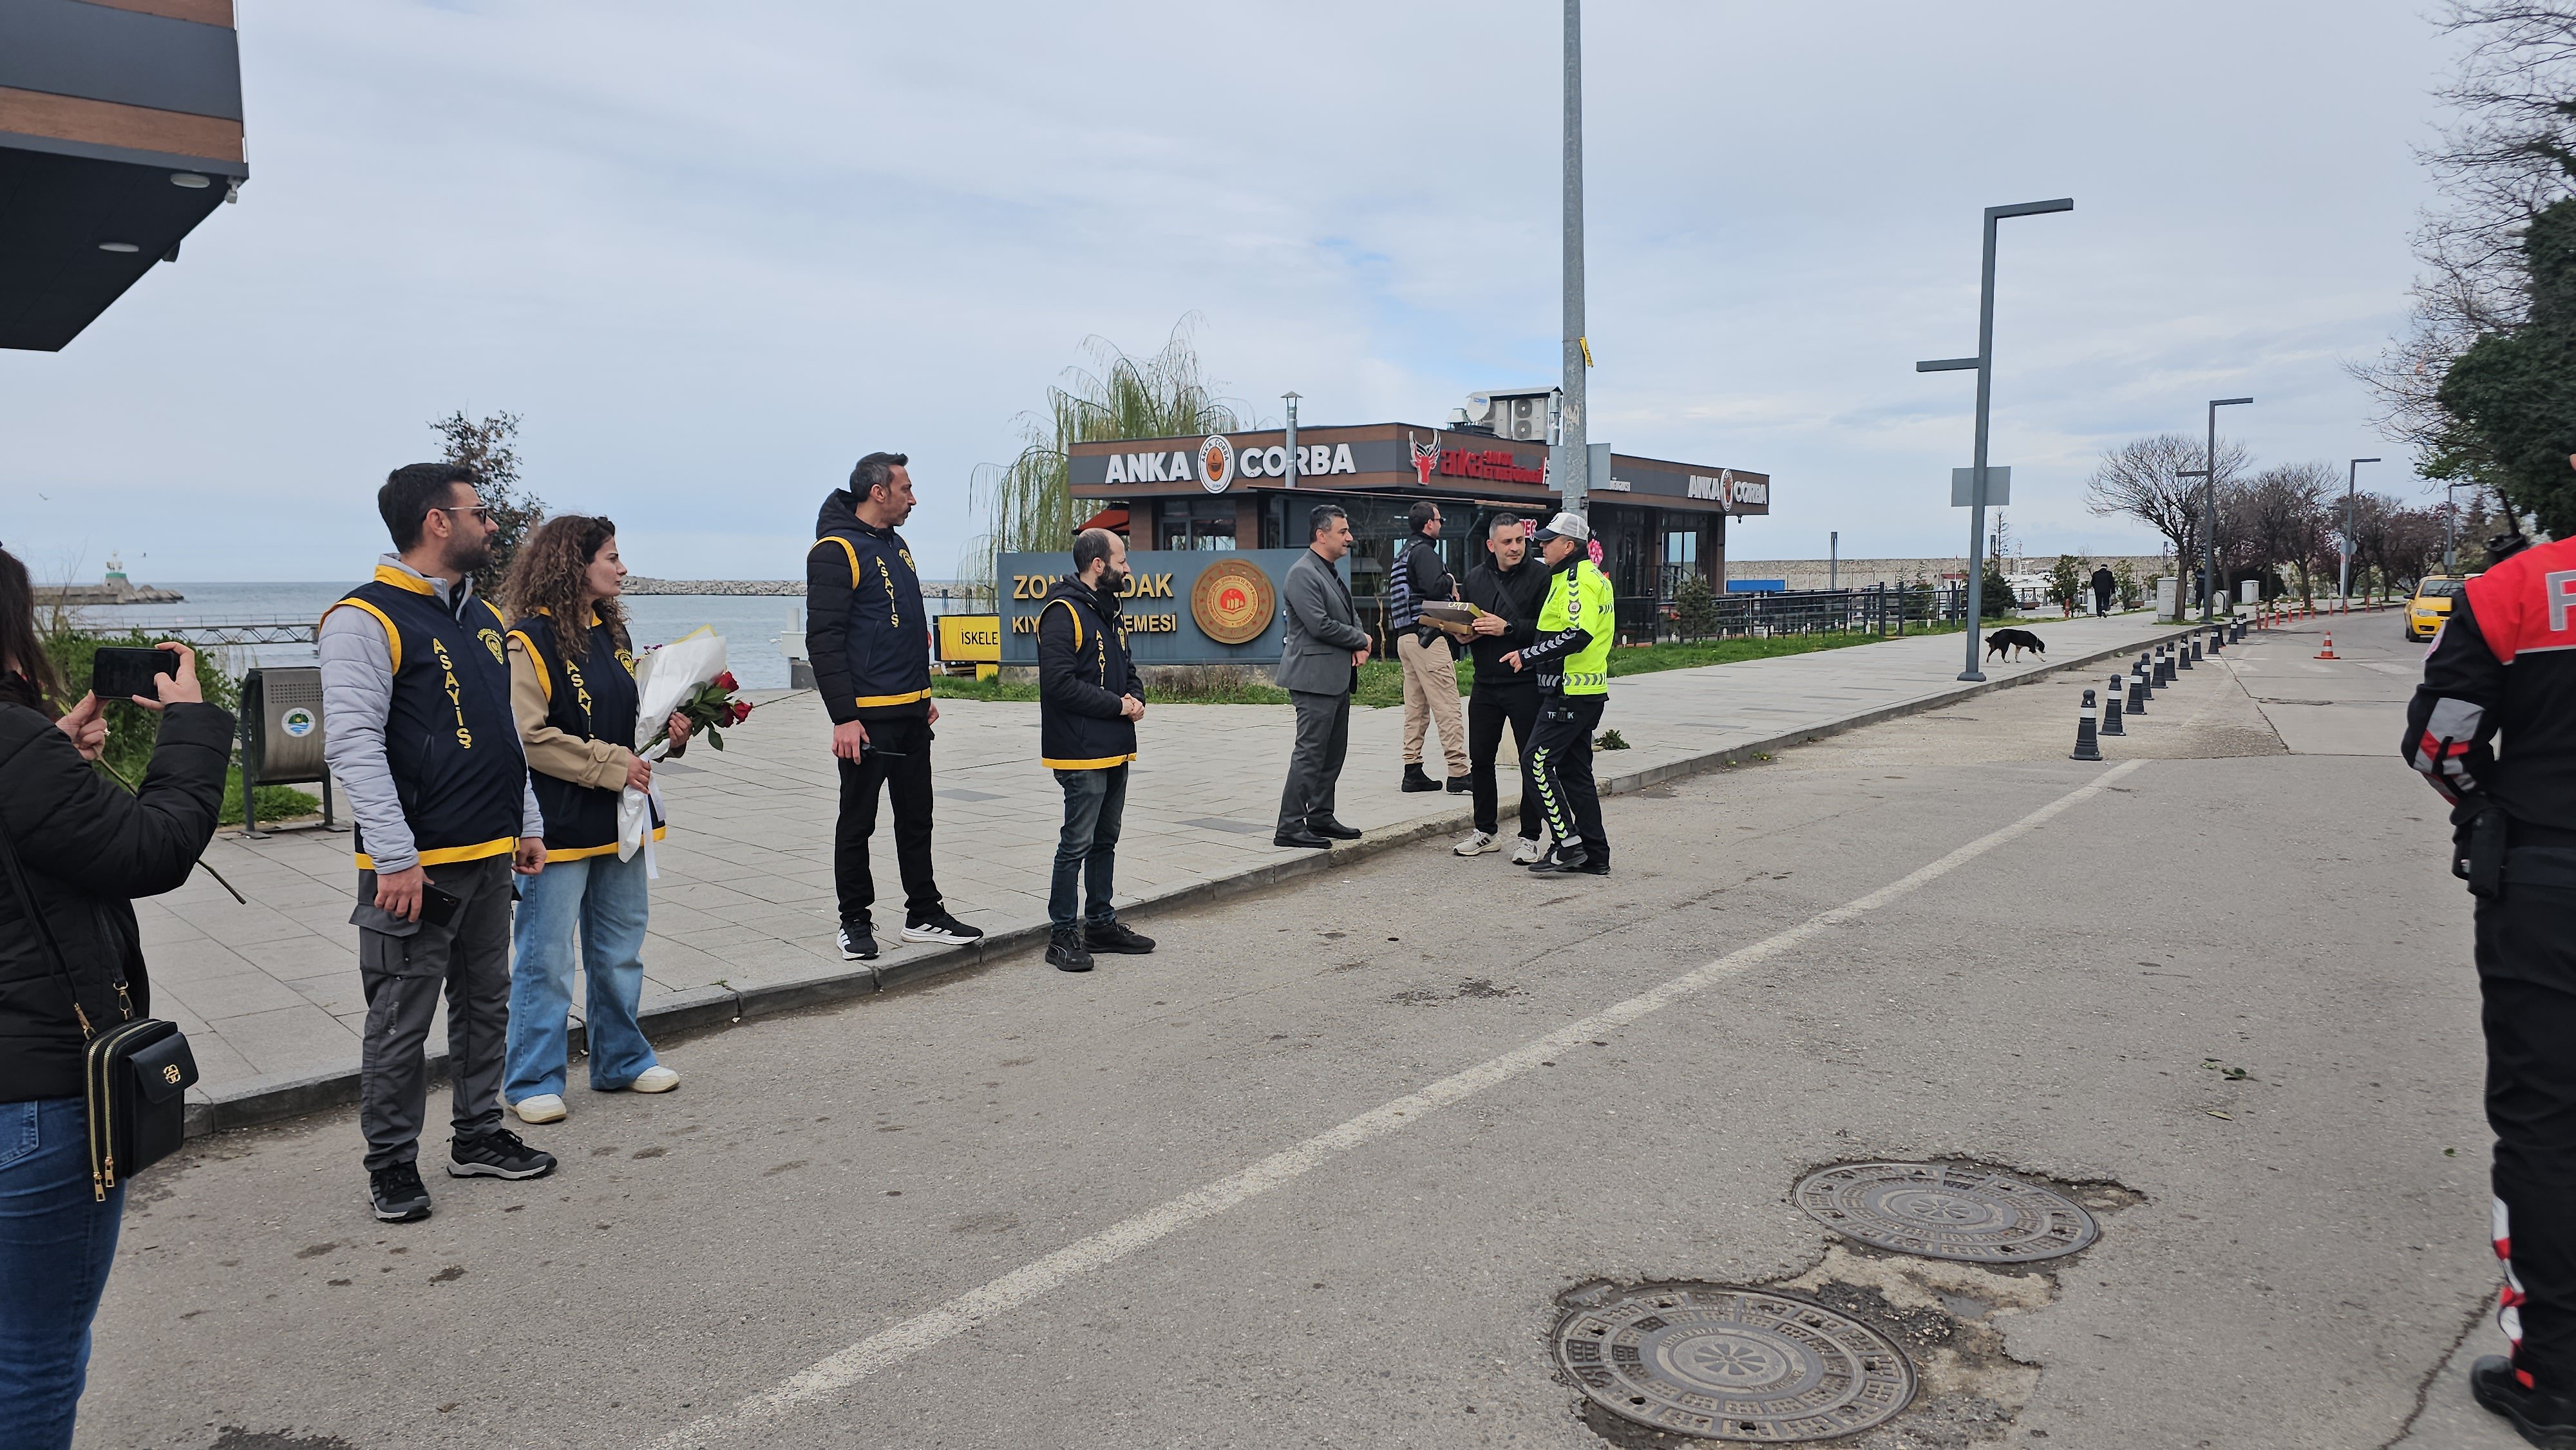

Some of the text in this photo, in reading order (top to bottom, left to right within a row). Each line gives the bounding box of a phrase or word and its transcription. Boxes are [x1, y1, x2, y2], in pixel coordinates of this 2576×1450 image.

[1104, 443, 1357, 484] ANKA ÇORBA
[1202, 439, 1229, 463] ANKA ÇORBA
[1687, 475, 1720, 500] ANKA
[876, 554, 900, 628] ASAYİŞ
[961, 627, 999, 645] İSKELE
[433, 637, 473, 750] ASAYİŞ
[565, 659, 596, 740] ASAYİ
